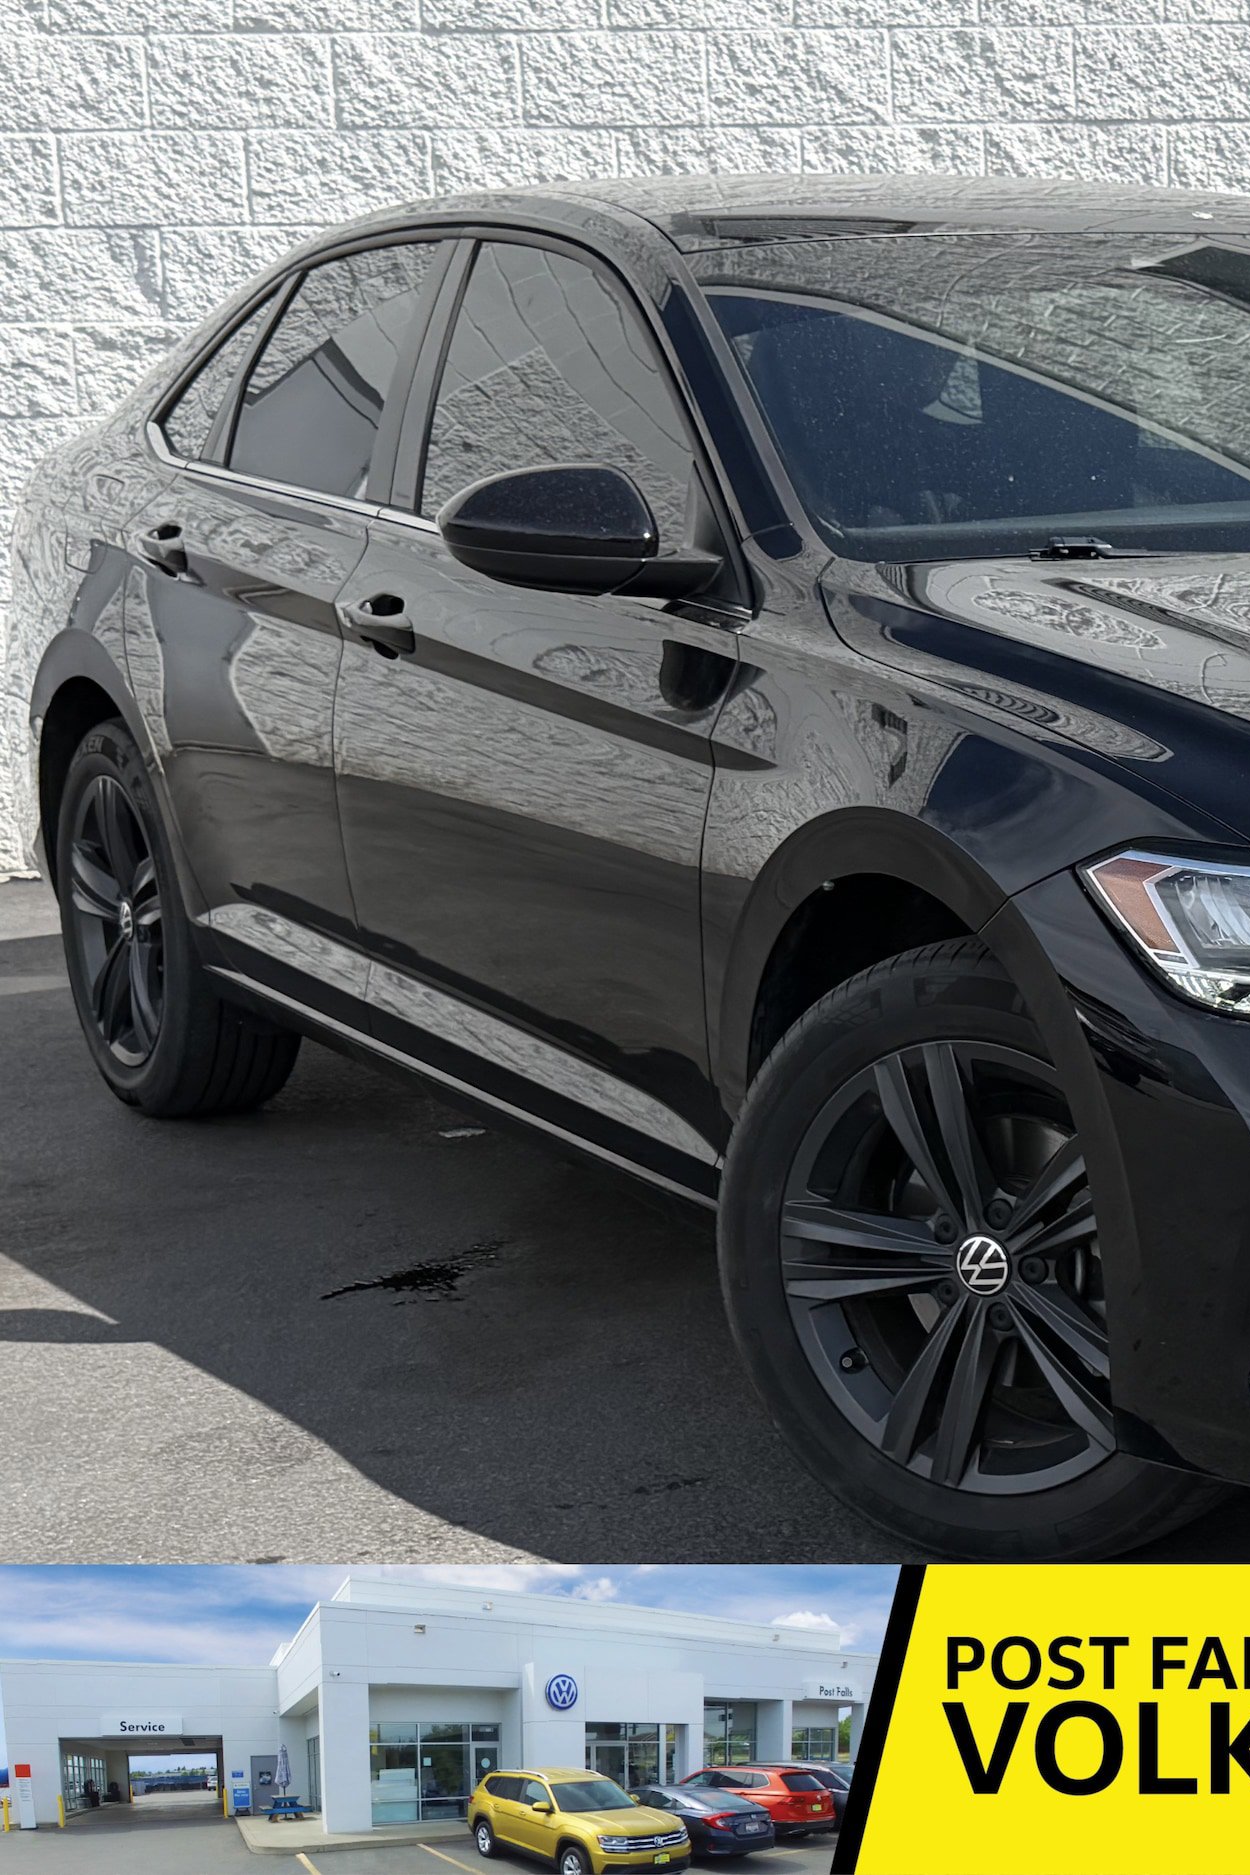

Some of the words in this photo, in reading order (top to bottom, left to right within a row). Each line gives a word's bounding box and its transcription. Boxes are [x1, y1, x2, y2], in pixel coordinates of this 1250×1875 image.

[819, 1685, 835, 1696] Post
[836, 1686, 853, 1697] Falls
[119, 1720, 165, 1732] Service
